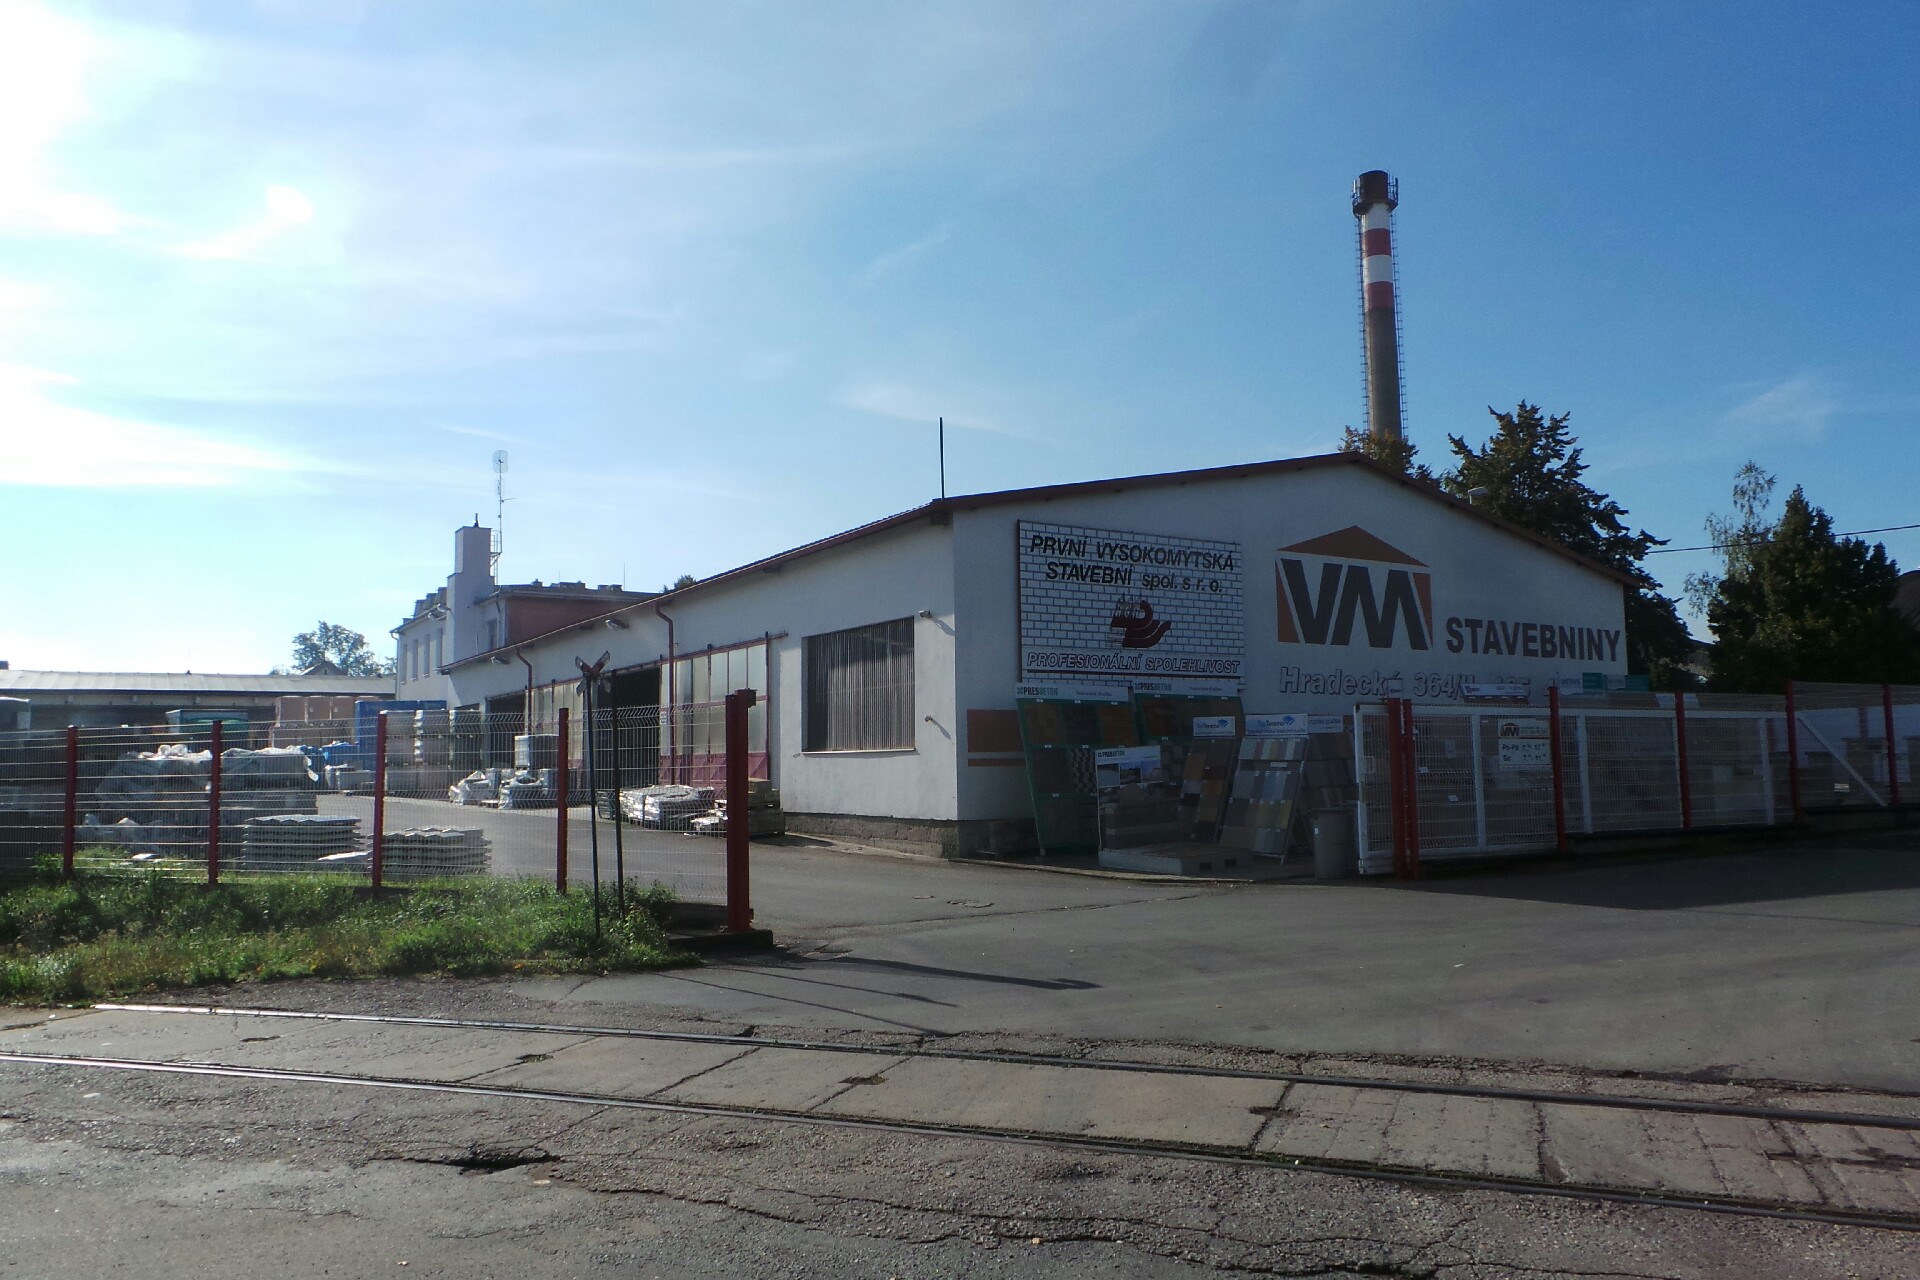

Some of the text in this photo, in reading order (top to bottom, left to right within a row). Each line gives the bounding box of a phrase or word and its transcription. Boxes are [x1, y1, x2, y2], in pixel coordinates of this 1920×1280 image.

[1030, 535, 1087, 557] PRVNÍ
[1046, 562, 1133, 585] STAVEBNÍ
[1142, 573, 1177, 591] spol.
[1210, 582, 1223, 593] o.
[1446, 617, 1621, 662] STAVEBNINY
[1027, 652, 1240, 673] PROFESIONÁLNÍ SPOLEHLIVOST
[1280, 666, 1402, 696] Hradeck
